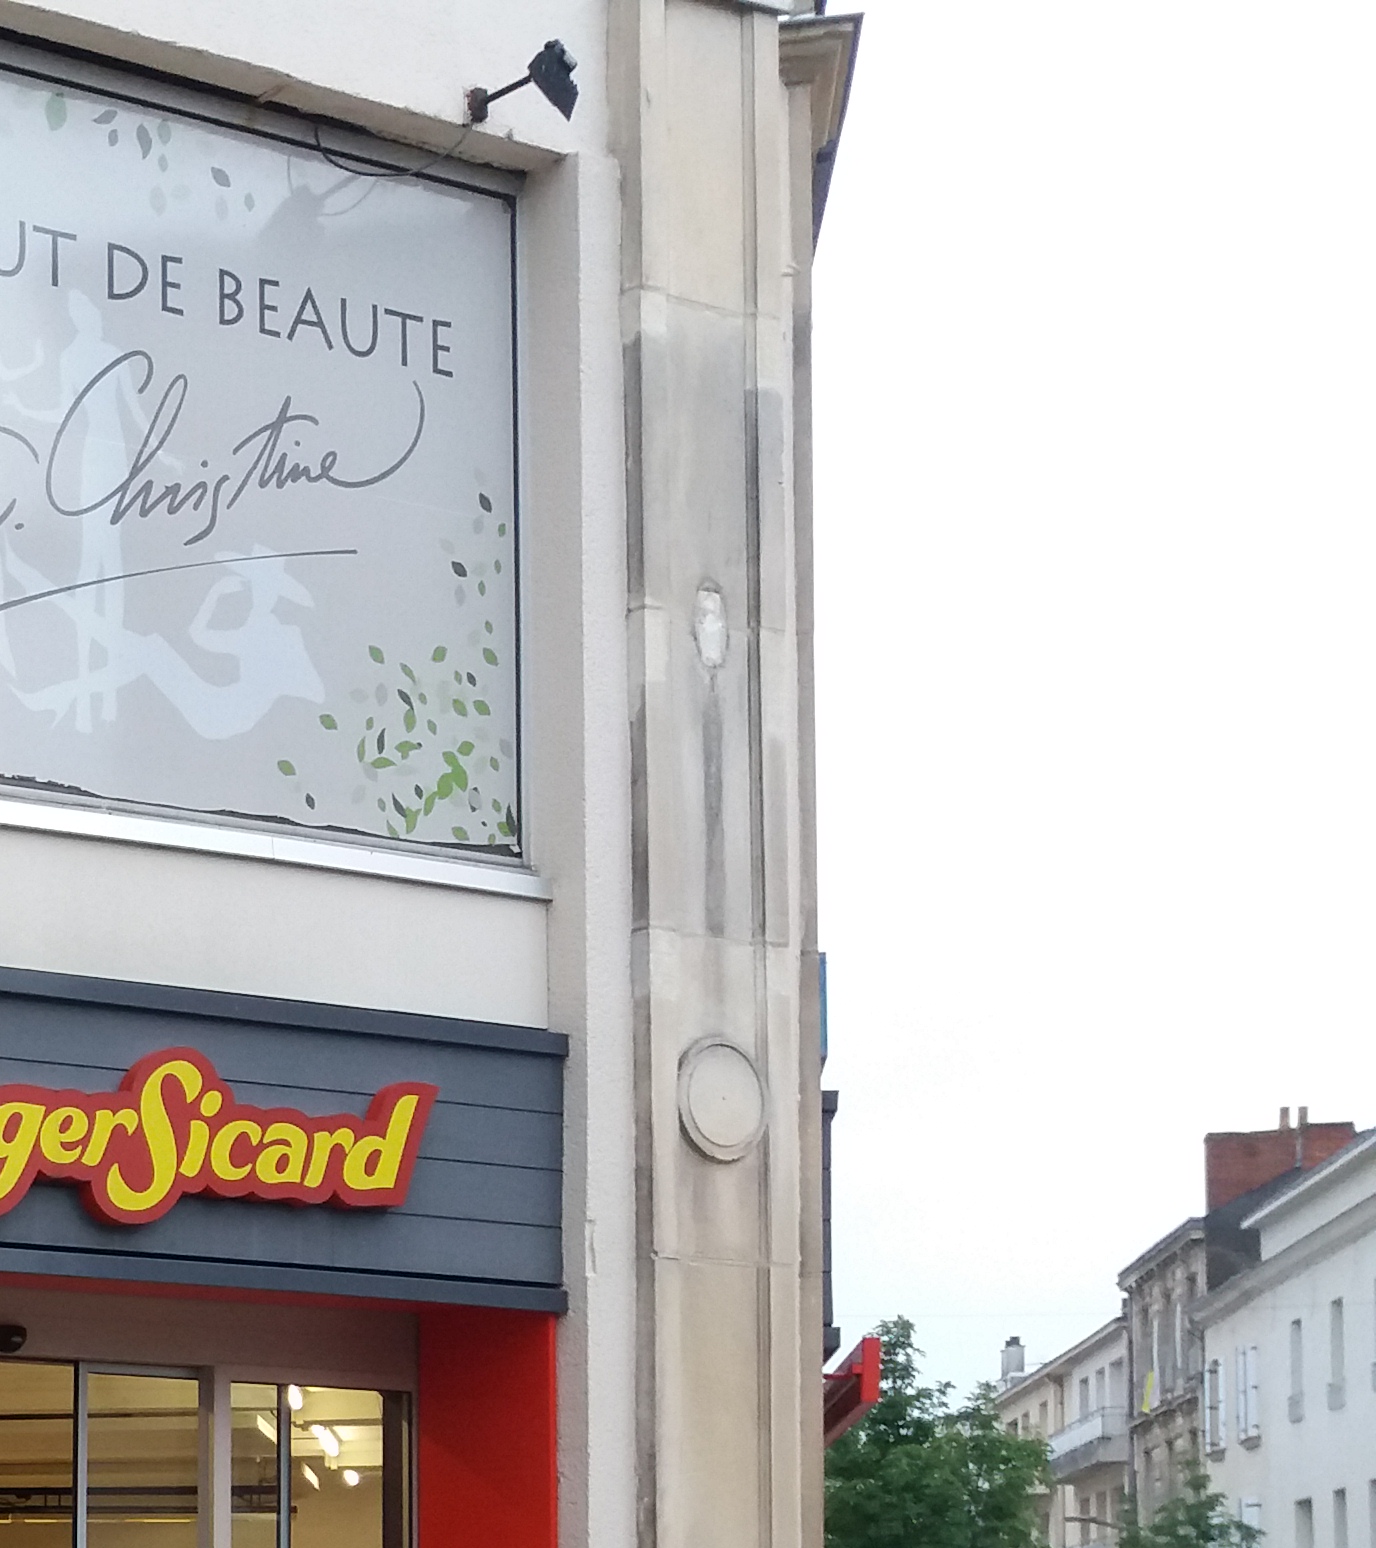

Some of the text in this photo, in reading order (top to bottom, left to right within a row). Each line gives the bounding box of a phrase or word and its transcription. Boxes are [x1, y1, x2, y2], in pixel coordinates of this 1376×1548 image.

[106, 242, 185, 316] DE
[218, 267, 454, 378] BEAUTE
[46, 350, 425, 546] Christine
